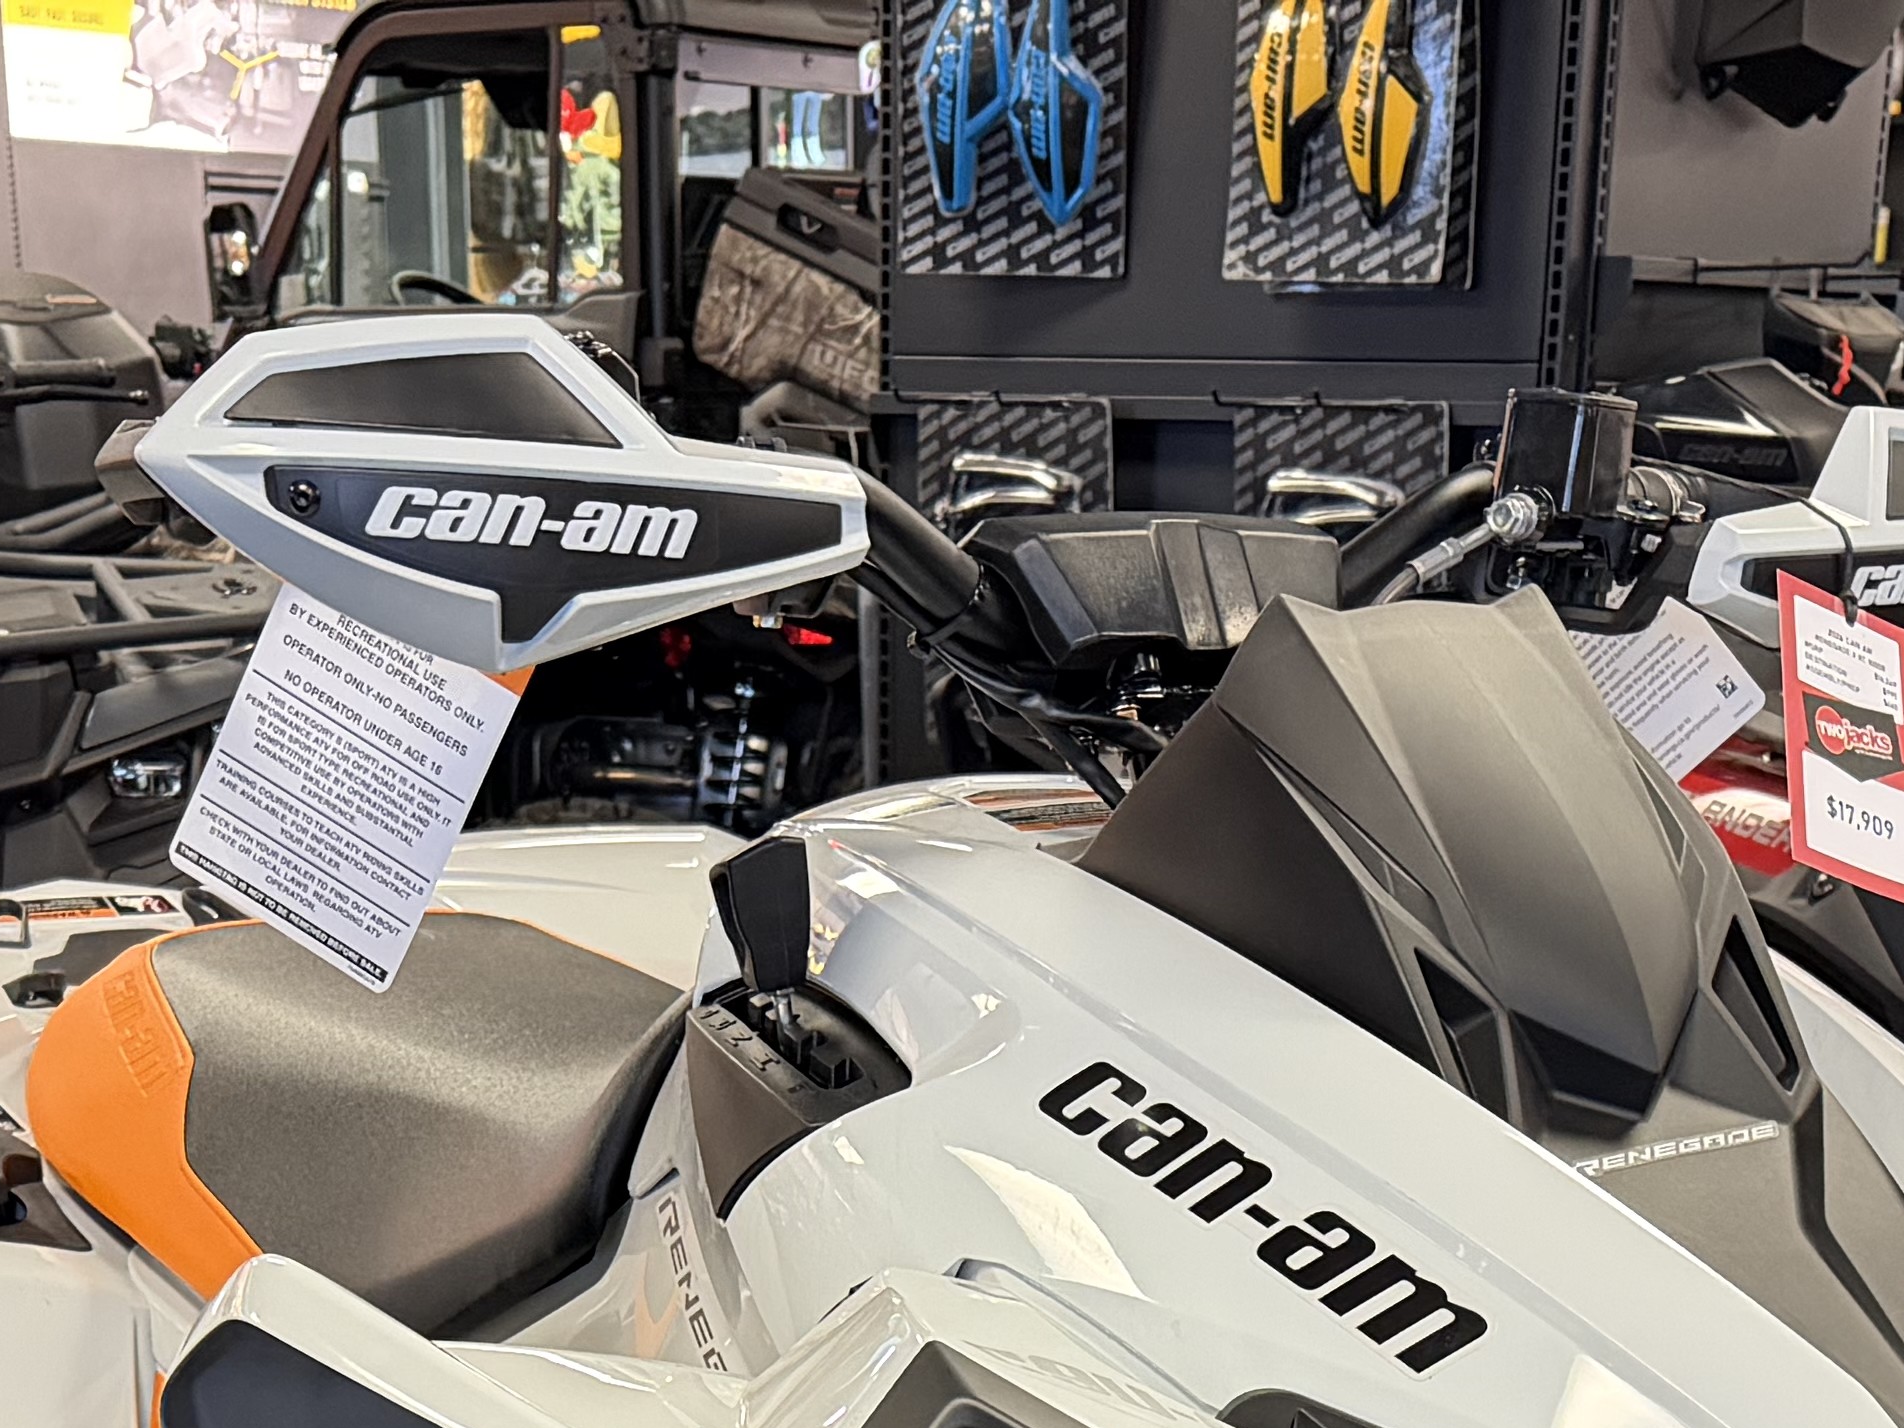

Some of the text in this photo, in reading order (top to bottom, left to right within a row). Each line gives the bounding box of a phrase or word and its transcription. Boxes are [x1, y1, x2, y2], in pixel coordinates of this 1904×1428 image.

[1262, 32, 1283, 142] can-am
[1352, 41, 1375, 157] can-am
[1677, 443, 1788, 467] can-am
[365, 485, 698, 560] can-am
[283, 634, 468, 757] OPERATOR ONLY-NO PASSENGERS
[288, 602, 486, 733] BY EXPERIENCED OPERATORS ONLY.
[336, 613, 447, 691] RECREATIONAL USE
[283, 669, 443, 776] NO OPERATOR UNDER AGE 16
[1843, 718, 1893, 754] jacks
[1702, 800, 1791, 853] ANDER
[1826, 795, 1895, 841] $17,909
[1573, 1124, 1775, 1176] RENEGADE
[1039, 1062, 1488, 1374] can-am
[658, 1196, 728, 1373] RENEG
